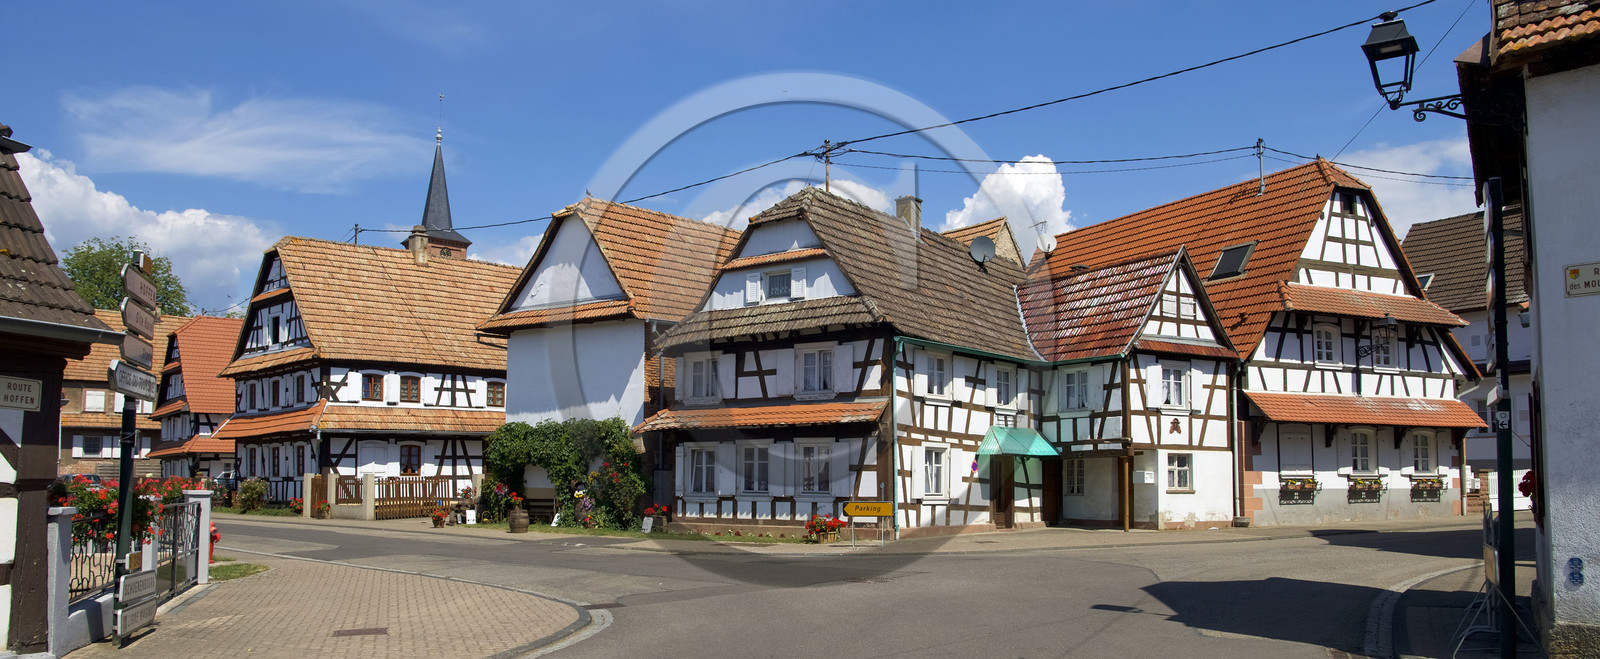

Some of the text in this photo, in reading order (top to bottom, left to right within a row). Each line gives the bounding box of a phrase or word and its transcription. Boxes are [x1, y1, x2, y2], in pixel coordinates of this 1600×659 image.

[1569, 282, 1581, 290] des
[140, 282, 156, 302] HOFFEN
[119, 370, 132, 385] OFFICE
[7, 382, 32, 393] ROUTE
[3, 394, 35, 405] HOFFEN
[854, 505, 881, 513] Parking
